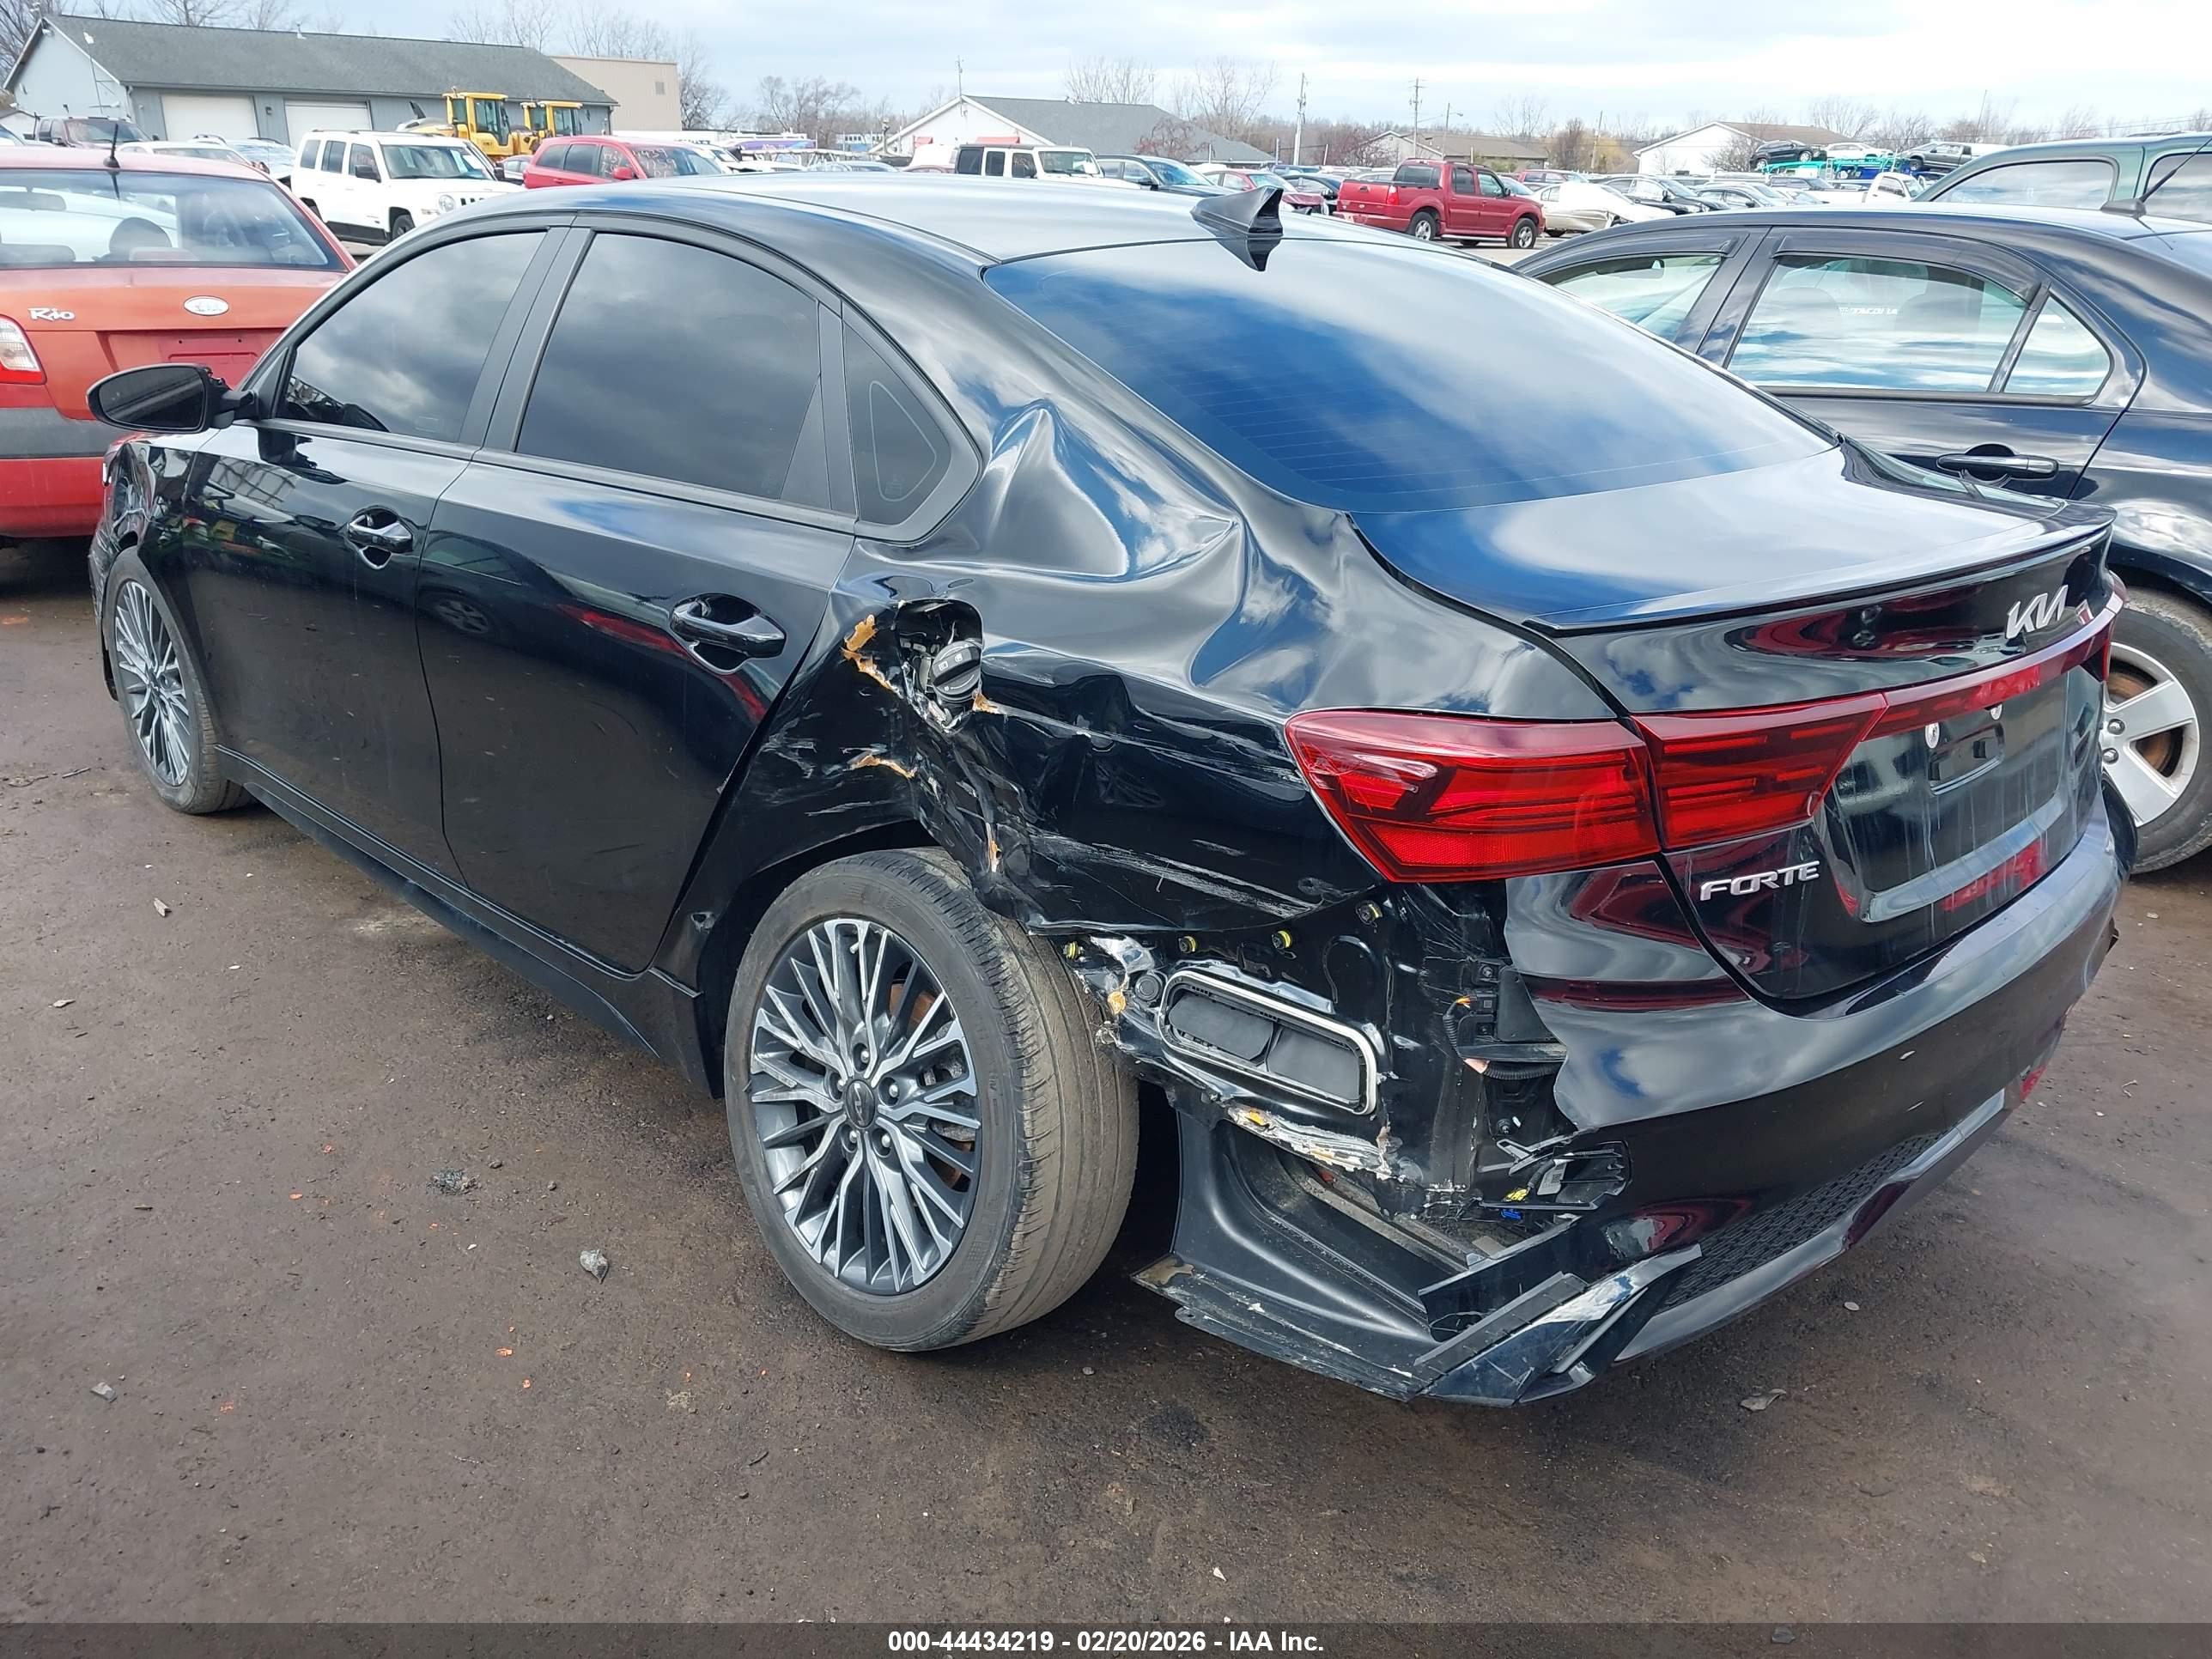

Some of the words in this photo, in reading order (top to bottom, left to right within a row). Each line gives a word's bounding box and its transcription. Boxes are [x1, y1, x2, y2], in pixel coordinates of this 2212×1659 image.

[27, 307, 76, 321] Rio
[2006, 585, 2069, 638] KIA
[1700, 860, 1820, 901] FORTE
